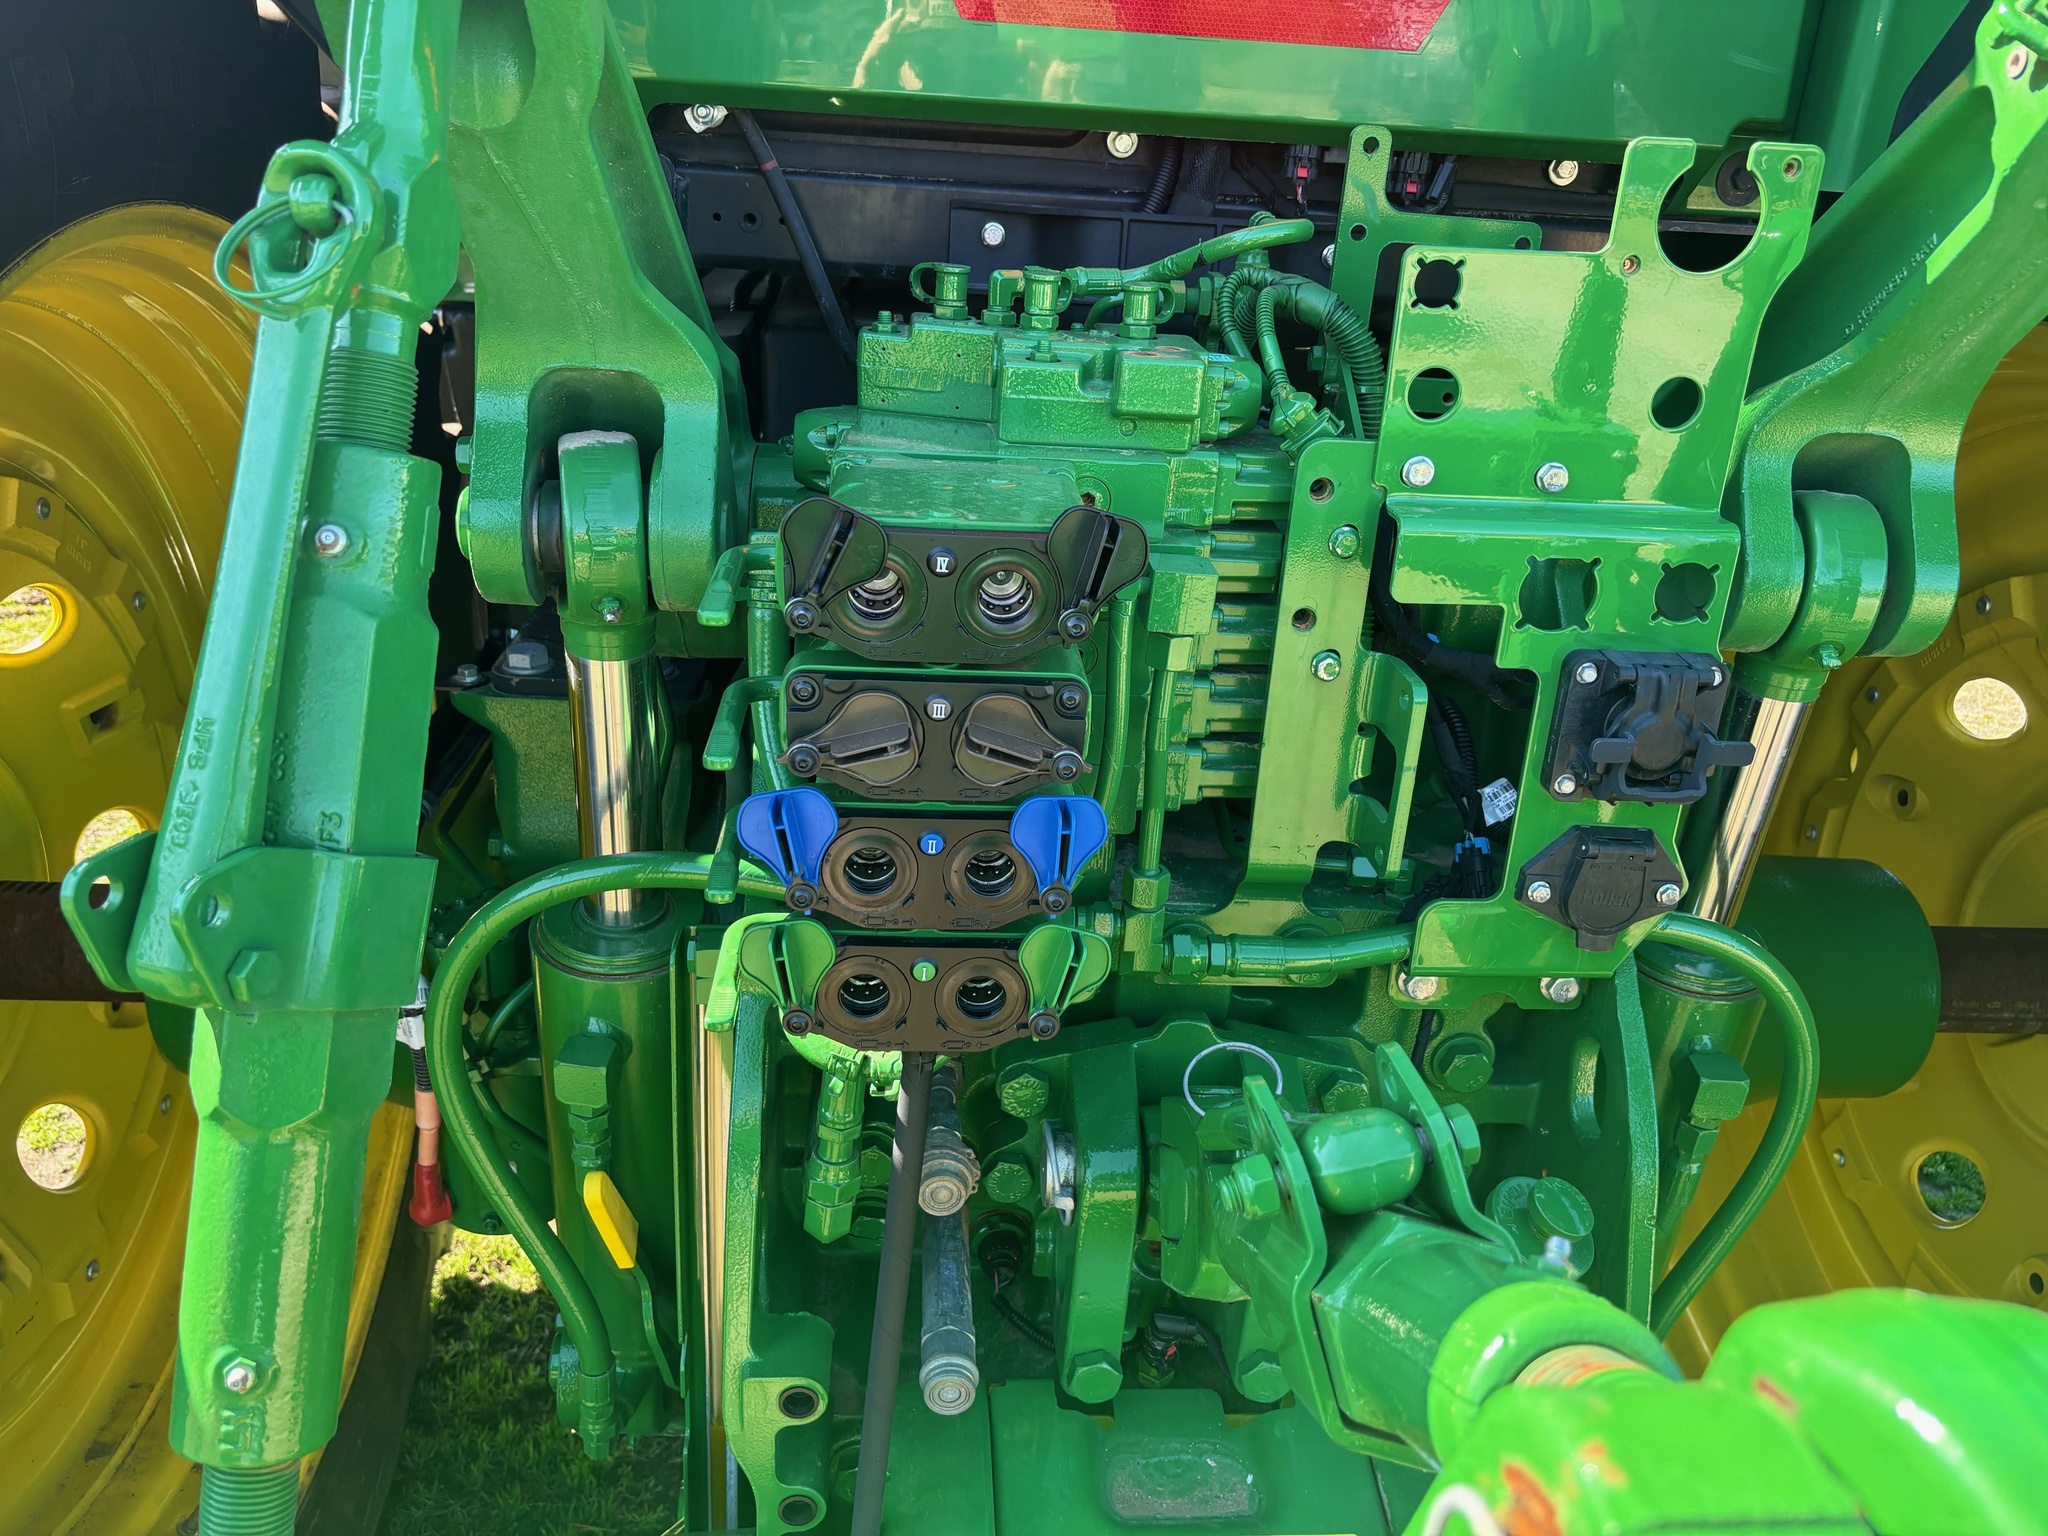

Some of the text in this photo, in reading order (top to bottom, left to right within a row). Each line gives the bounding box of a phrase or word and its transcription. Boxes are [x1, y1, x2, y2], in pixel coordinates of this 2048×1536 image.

[936, 556, 950, 573] IV
[931, 703, 946, 719] III
[927, 839, 937, 854] II
[1580, 888, 1632, 908] Pollak
